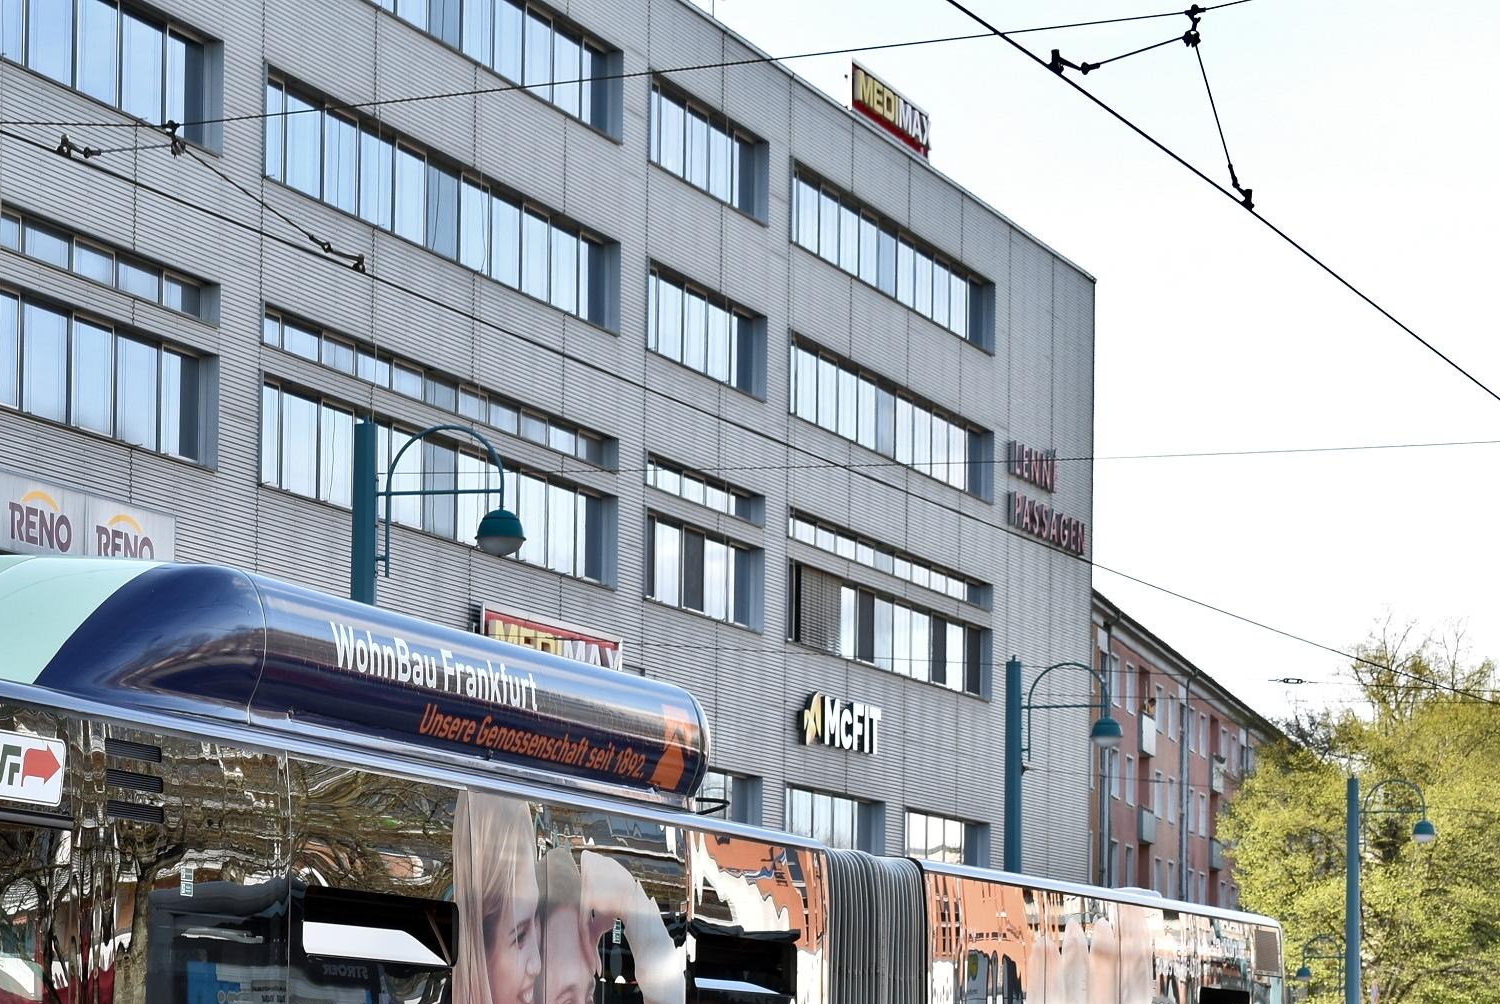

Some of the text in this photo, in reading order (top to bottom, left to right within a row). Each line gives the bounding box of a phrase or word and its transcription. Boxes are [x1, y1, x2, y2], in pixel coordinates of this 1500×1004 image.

[857, 69, 931, 150] MEDIMAX
[8, 501, 72, 553] RENO
[1014, 492, 1085, 554] PASSAGEN
[330, 621, 538, 711] WohnBau Frankfurt
[419, 703, 646, 779] Unsere Genossenschaft seit 1892.
[824, 695, 882, 755] McFIT
